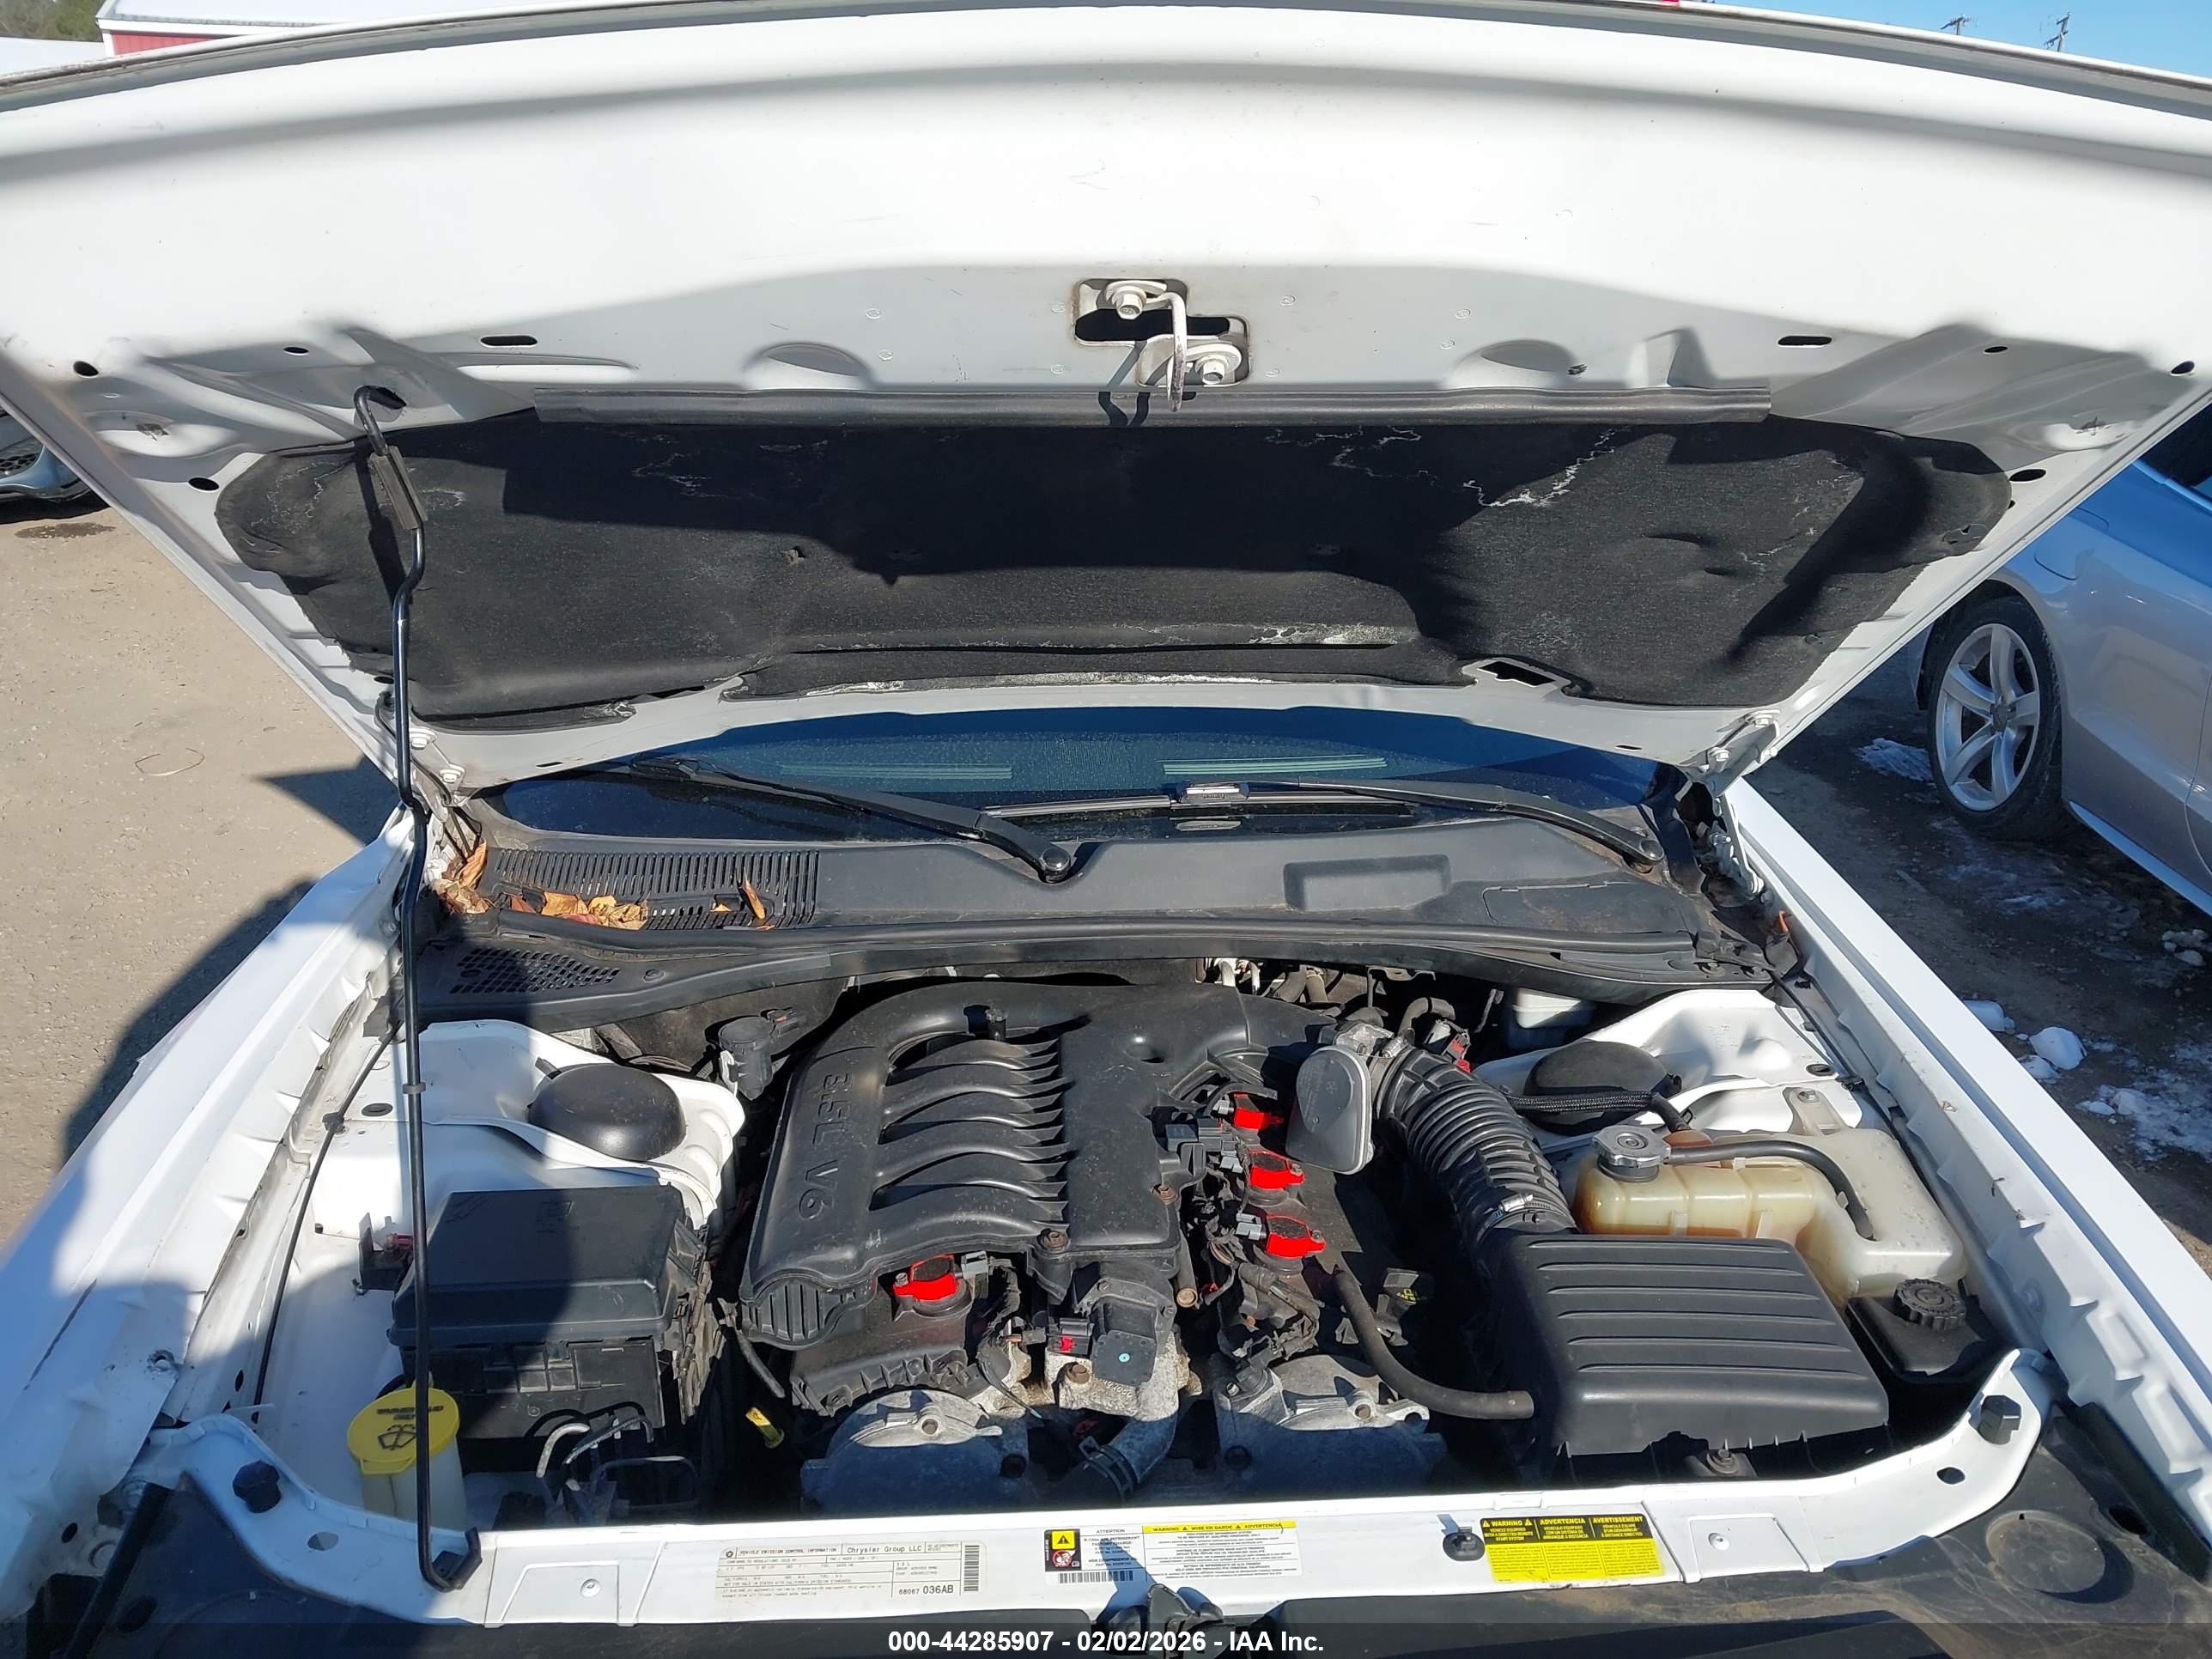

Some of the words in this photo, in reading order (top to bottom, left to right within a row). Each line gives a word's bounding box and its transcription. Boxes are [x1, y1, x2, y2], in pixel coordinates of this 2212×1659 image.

[812, 1073, 853, 1146] 3.5L
[797, 1159, 839, 1221] V6
[847, 1546, 880, 1555] Chrysler
[922, 1584, 954, 1595] 036AB
